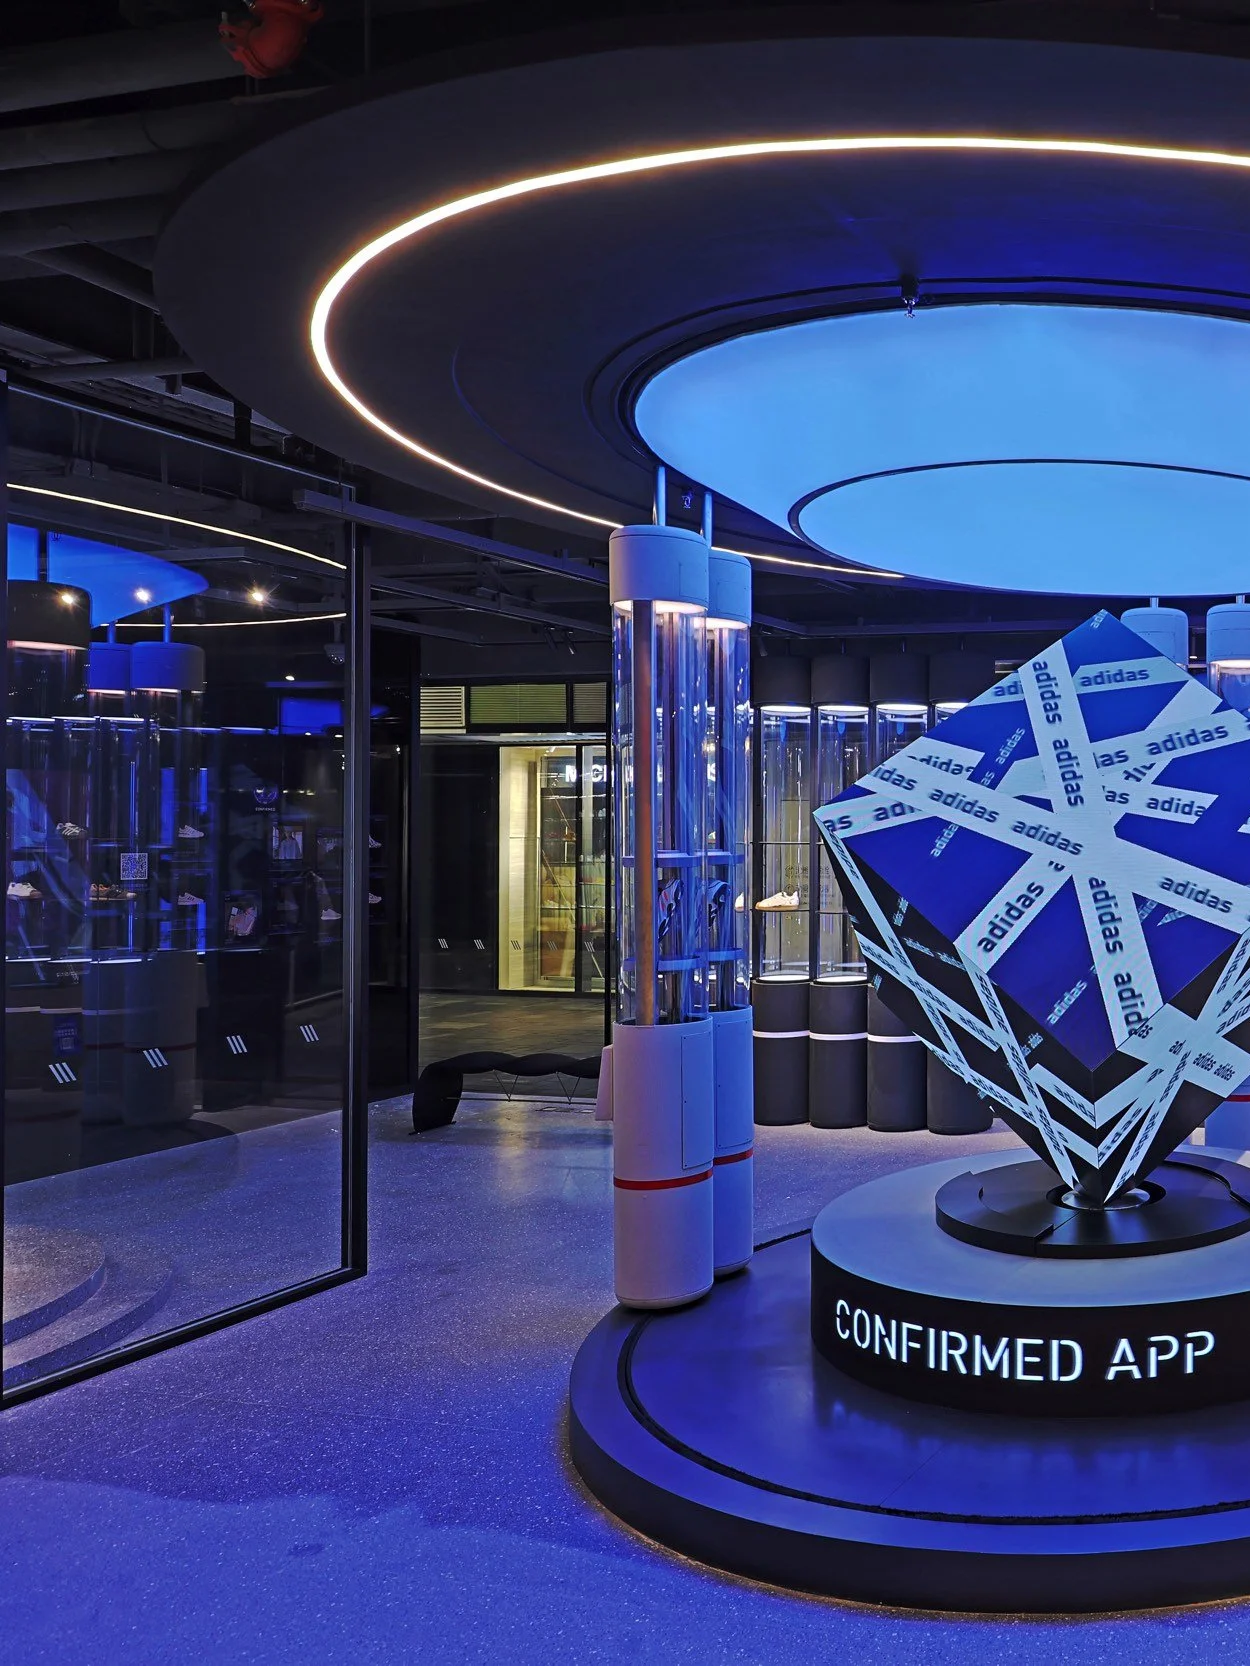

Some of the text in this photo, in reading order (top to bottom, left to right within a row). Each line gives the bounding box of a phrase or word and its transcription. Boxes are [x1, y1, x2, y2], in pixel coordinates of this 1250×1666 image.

[1081, 669, 1150, 687] adidas
[995, 727, 1025, 764] adidas
[1033, 661, 1084, 807] adidas adidas
[1146, 725, 1229, 756] adidas
[1147, 796, 1207, 817] adida
[873, 764, 918, 791] idas
[929, 788, 1000, 823] adidas
[1012, 820, 1083, 856] adidas
[1160, 875, 1234, 914] adidas
[930, 823, 958, 858] adida
[977, 882, 1045, 953] adidas
[1089, 877, 1123, 955] adidas
[1217, 937, 1250, 994] adidas
[1046, 979, 1088, 1025] adidas
[976, 973, 1009, 1033] adidas
[1008, 1043, 1038, 1098] adidas
[836, 1299, 1216, 1382] CONFIRMED APP
